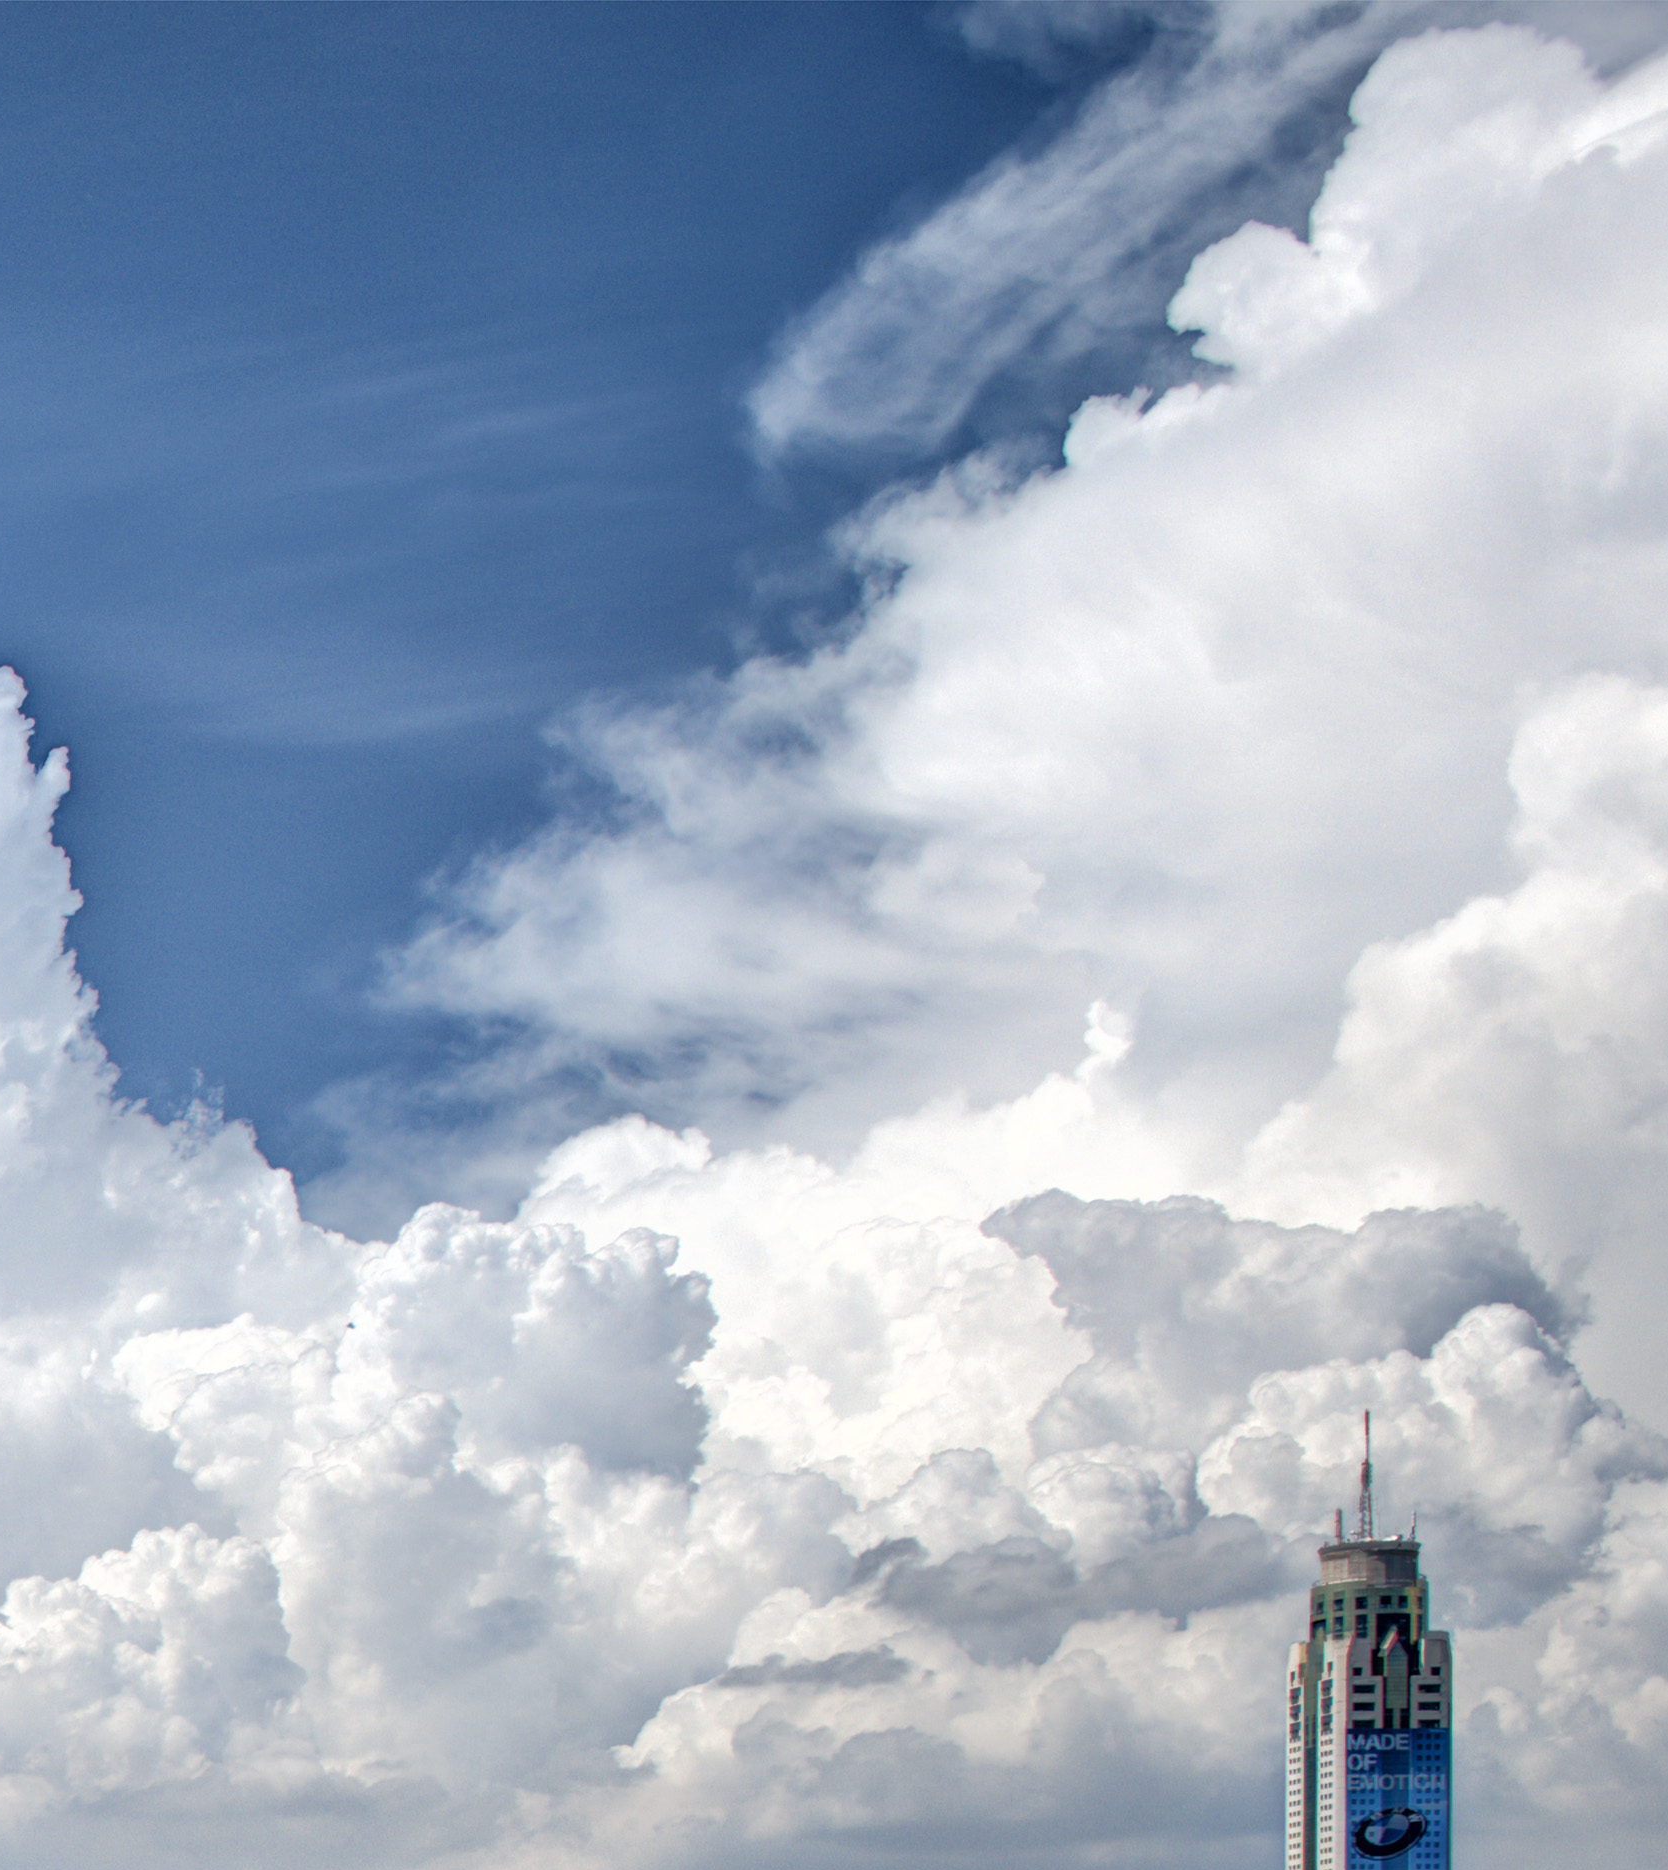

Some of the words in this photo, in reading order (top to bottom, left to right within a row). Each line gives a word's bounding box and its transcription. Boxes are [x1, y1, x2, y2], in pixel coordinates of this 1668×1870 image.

[1347, 1733, 1410, 1750] MADE
[1347, 1753, 1378, 1771] OF
[1347, 1773, 1447, 1790] EMOTION
